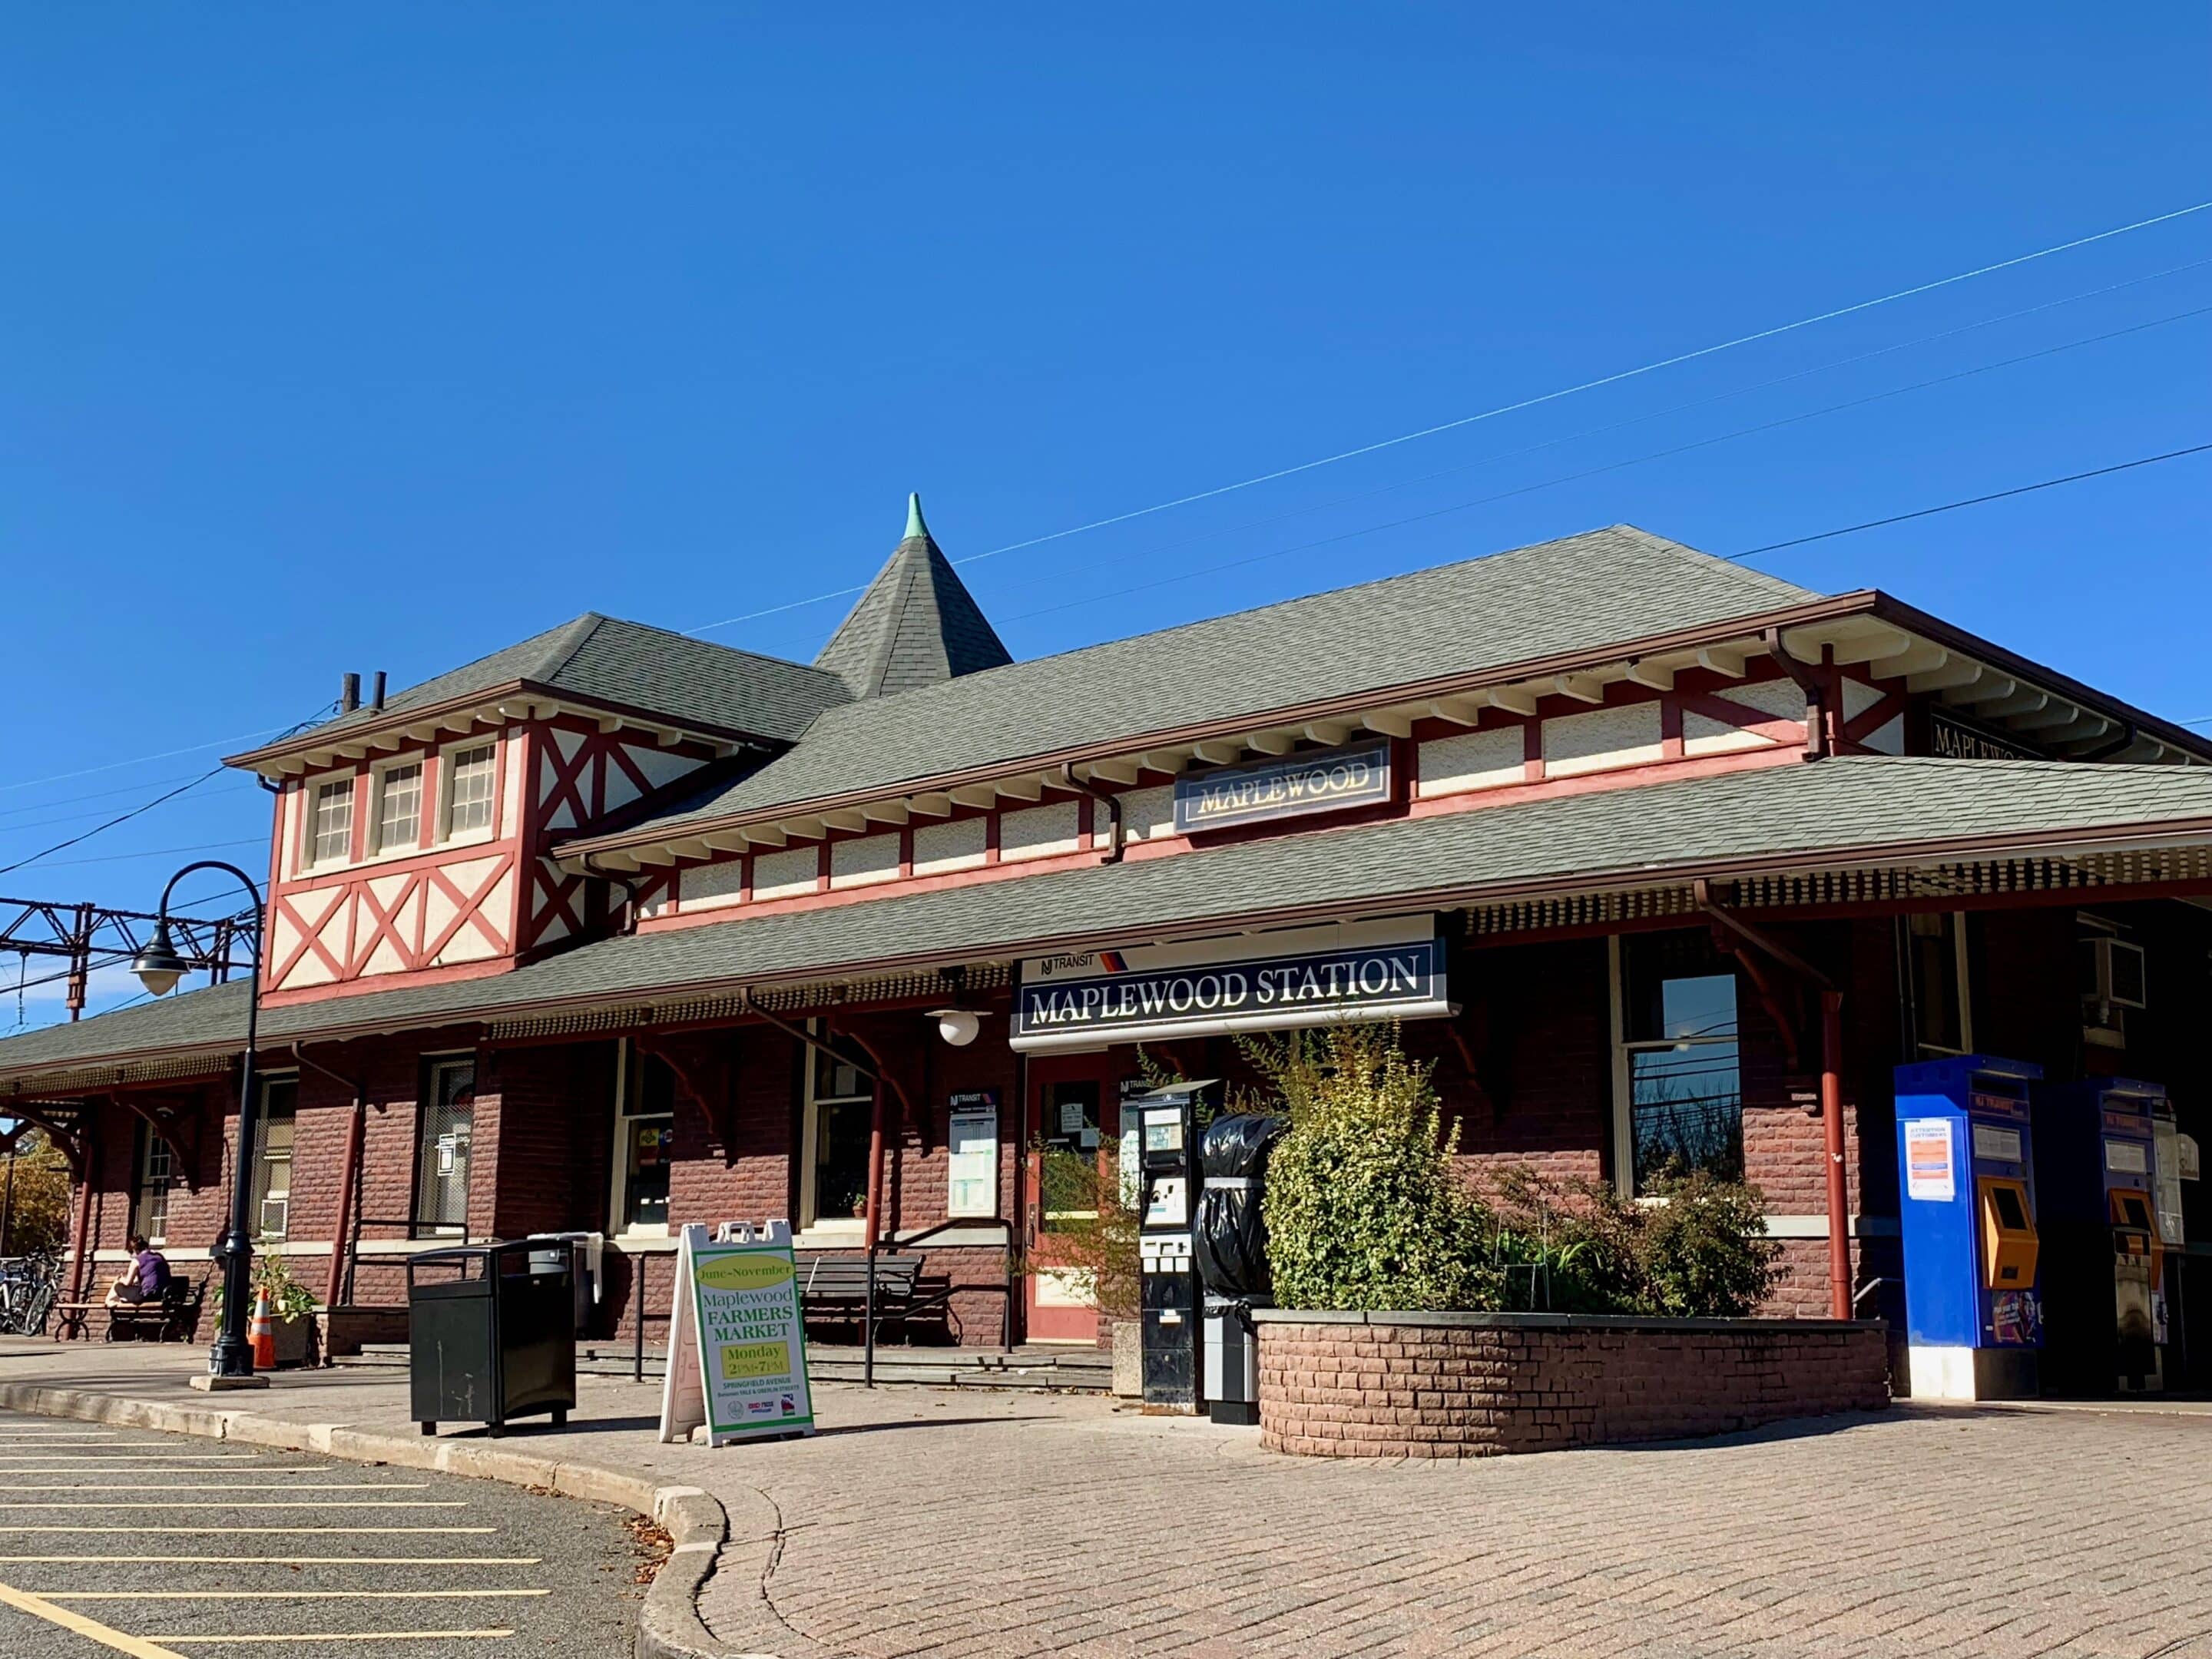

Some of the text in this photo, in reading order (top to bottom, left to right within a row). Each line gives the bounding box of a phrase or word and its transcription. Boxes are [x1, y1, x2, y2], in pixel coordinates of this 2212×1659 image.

[1197, 762, 1369, 813] MAPLEWOOD
[1054, 954, 1094, 971] TRANSIT
[1031, 955, 1419, 1025] MAPLEWOOD STATION
[959, 1094, 981, 1102] TRANSIT
[704, 1288, 793, 1309] Maplewood
[708, 1306, 793, 1326] FARMERS
[714, 1323, 790, 1342] MARKET
[728, 1346, 781, 1360] Monday
[723, 1376, 791, 1389] SPRINGFIELD AVENUE
